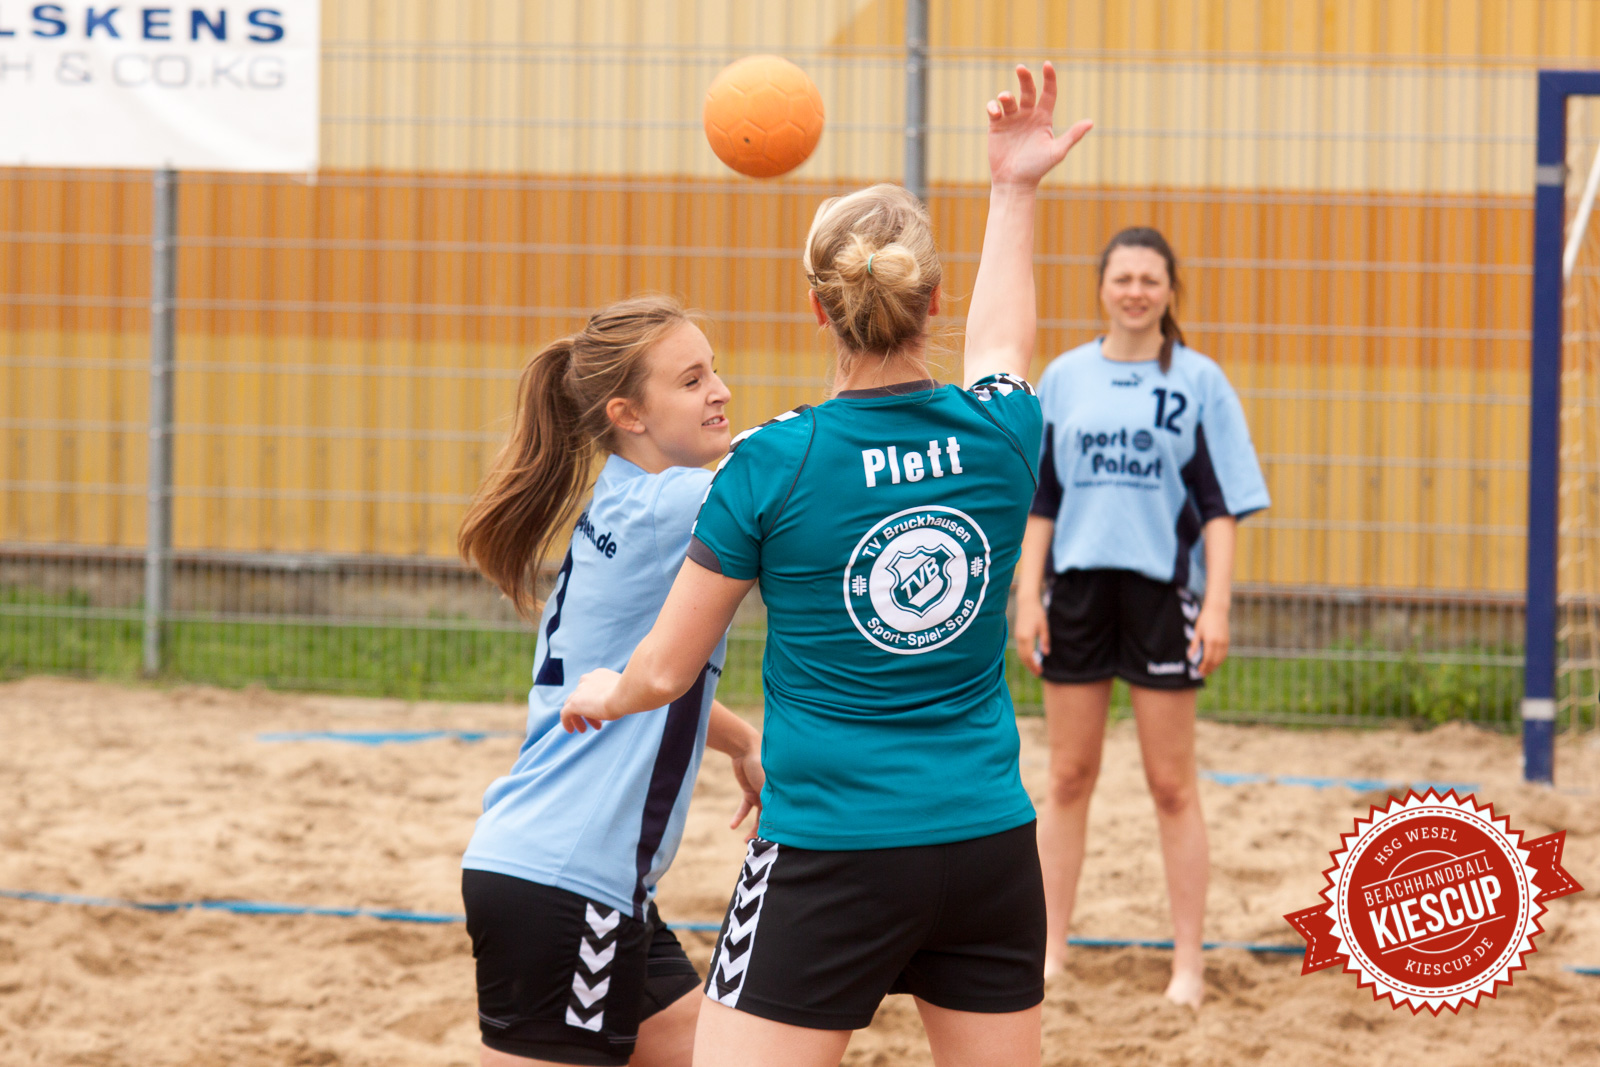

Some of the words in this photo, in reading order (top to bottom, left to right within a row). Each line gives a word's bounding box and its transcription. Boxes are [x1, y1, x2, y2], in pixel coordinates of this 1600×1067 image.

[55, 50, 92, 86] &
[112, 53, 287, 90] CO.KG
[1152, 387, 1188, 436] 12
[861, 436, 963, 488] Plett
[1076, 427, 1127, 456] port
[1092, 452, 1162, 479] Palast
[862, 536, 882, 559] TV
[882, 514, 972, 543] Bruckhausen
[900, 556, 940, 600] TVB
[867, 599, 975, 648] Sport-Spiel-Spaß
